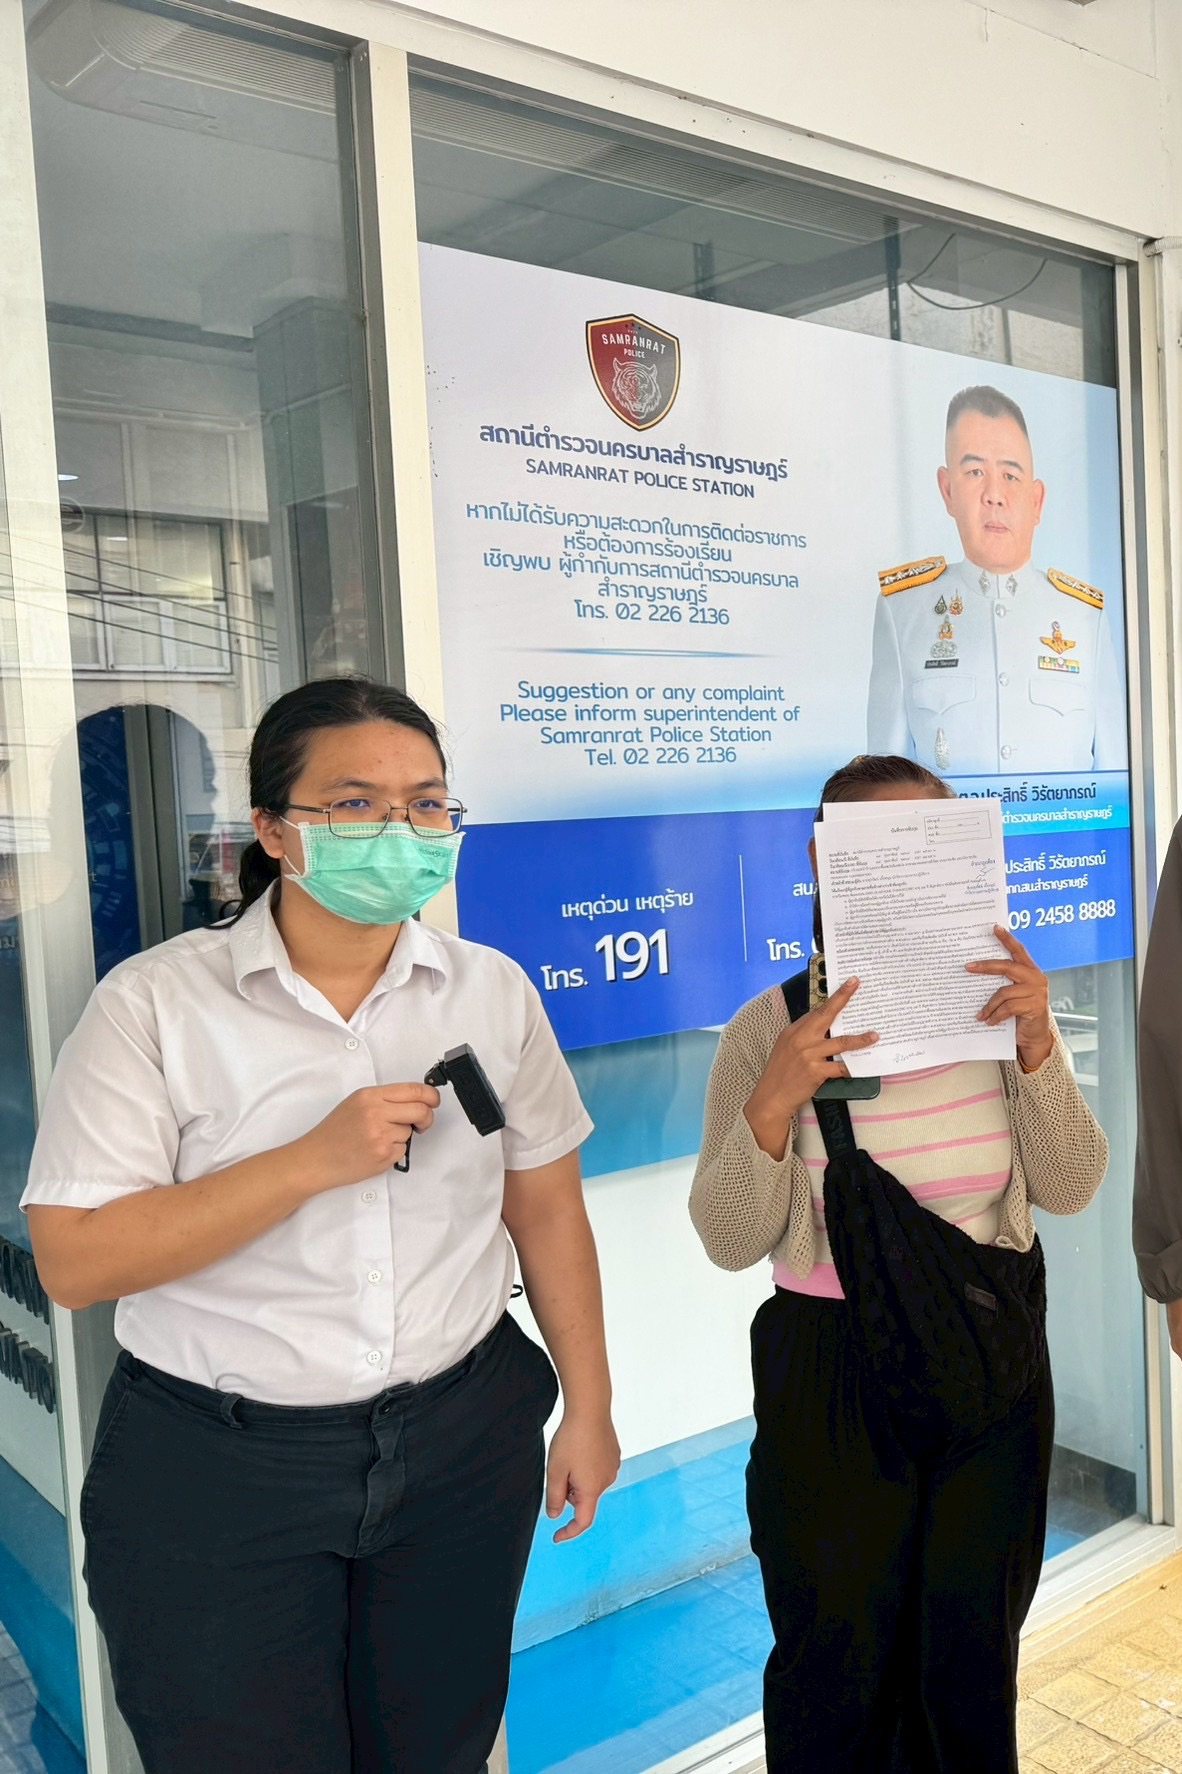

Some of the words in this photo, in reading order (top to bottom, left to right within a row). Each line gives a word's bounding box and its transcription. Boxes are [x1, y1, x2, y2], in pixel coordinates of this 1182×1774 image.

[601, 333, 666, 354] SAMRANRAT
[624, 349, 645, 358] POLICE
[479, 424, 789, 480] สถานีตำรวจนครบาลสำราญราษฎร์
[526, 459, 629, 485] SAMRANRAT
[634, 471, 688, 491] POLICE
[692, 478, 755, 498] STATION
[466, 500, 807, 549] หากไม่ได้รับความสะดวกในการติดต่อราชการ
[563, 531, 732, 564] หรือต้องการร้องเรียน
[483, 547, 551, 573] เชิญพบ
[559, 553, 799, 588] ผู้กำกับการสถานีตำรวจนครบาล
[598, 576, 708, 604] สำราญราษฎร์
[574, 599, 609, 620] โทร.
[615, 603, 642, 621] 02
[648, 604, 683, 623] 226
[688, 606, 731, 625] 2136
[517, 680, 629, 702] Suggestion
[636, 684, 656, 701] or
[662, 684, 696, 703] any
[702, 684, 785, 703] complaint
[500, 704, 567, 722] Please
[575, 704, 637, 722] inform
[643, 705, 778, 724] superintendent
[783, 705, 801, 722] of
[540, 727, 642, 745] Samranrat
[650, 727, 704, 743] Police
[710, 726, 772, 742] Station
[584, 749, 617, 766] Tel.
[623, 748, 649, 765] 02
[656, 747, 689, 764] 226
[696, 747, 737, 764] 2136
[1032, 782, 1097, 801] วิรัตยาภรณ์
[1048, 850, 1106, 870] วิรัตยาภรณ์
[561, 893, 629, 921] เหตุด่วน
[636, 890, 694, 915] เหตุร้าย
[1035, 904, 1075, 928] 2458
[1078, 898, 1117, 922] 8888
[540, 964, 588, 992] โทร.
[595, 928, 670, 982] 191
[766, 938, 805, 962] โทร.
